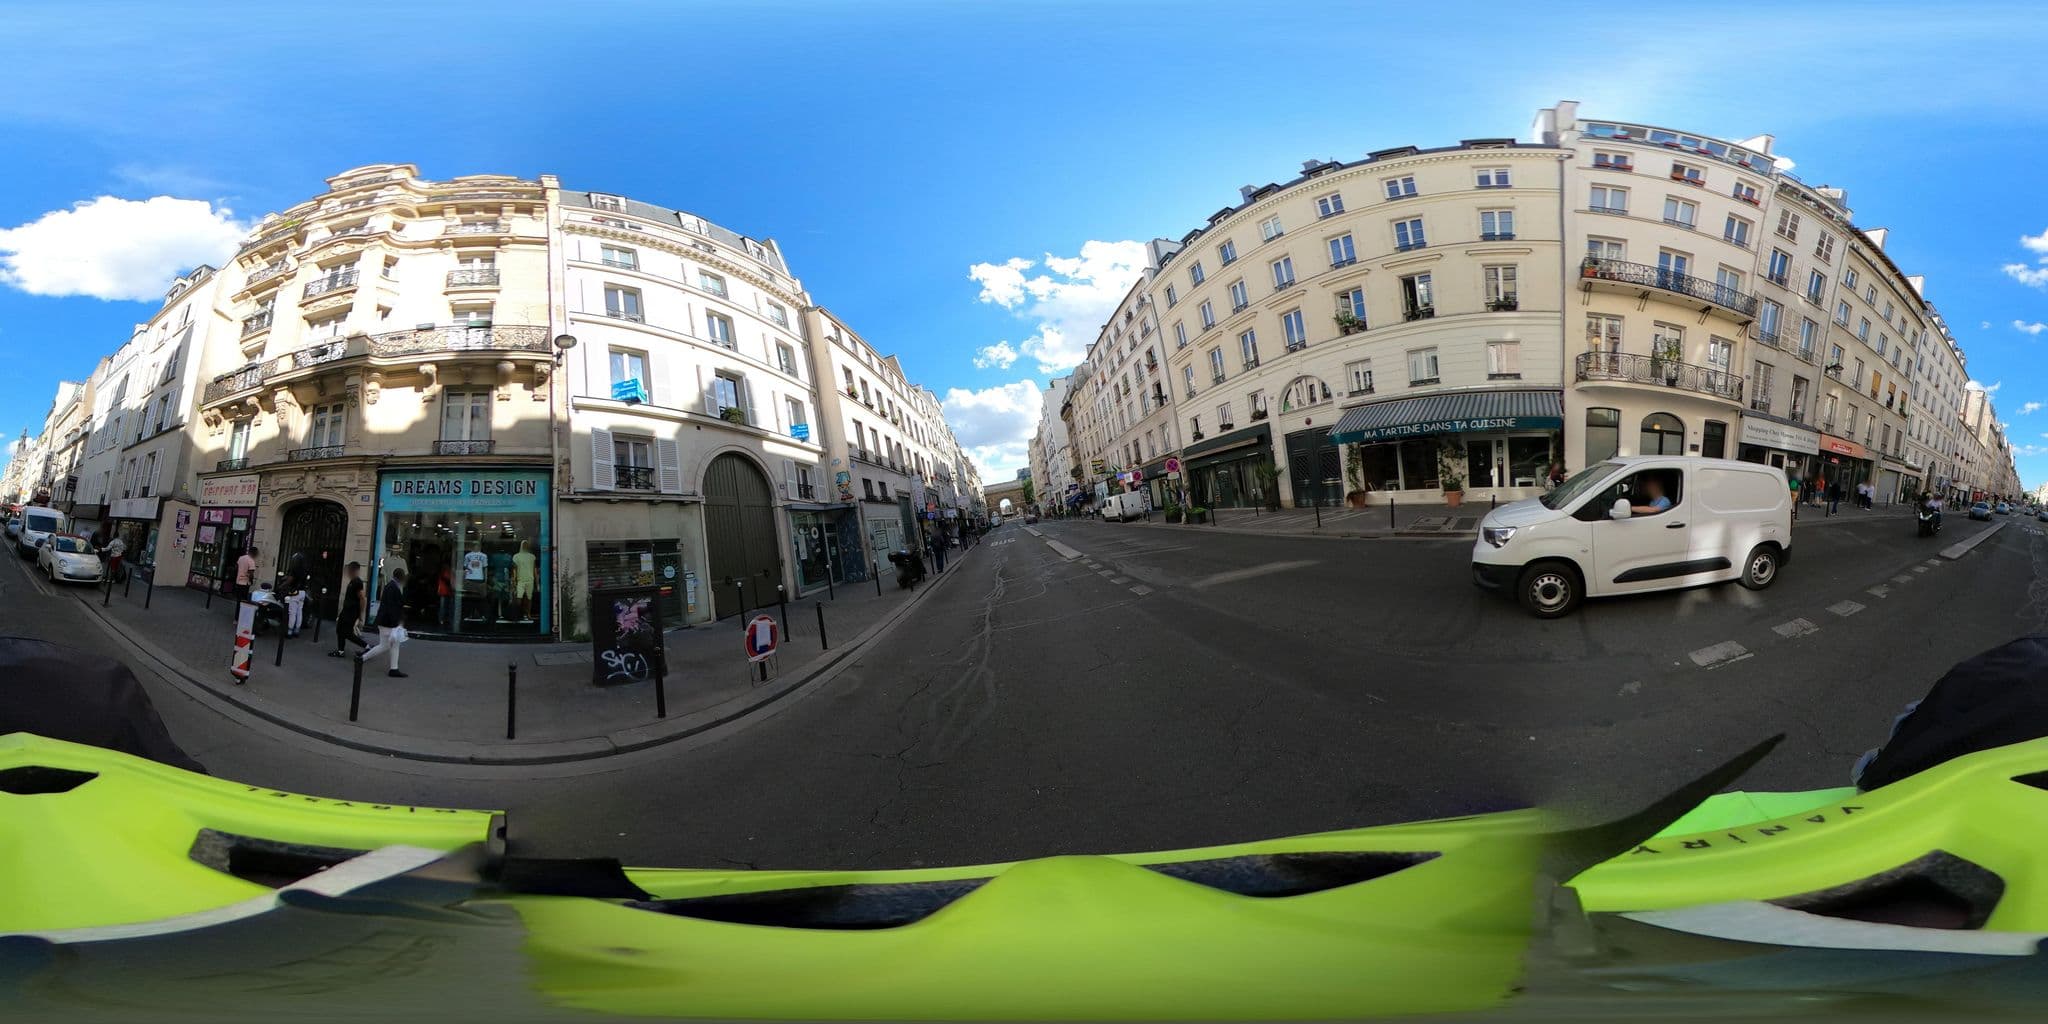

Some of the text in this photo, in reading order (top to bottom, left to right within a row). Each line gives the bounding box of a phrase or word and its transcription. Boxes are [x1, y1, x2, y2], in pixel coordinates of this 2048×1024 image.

[1363, 418, 1516, 439] MA TARTINE DANS TA CUISINE
[392, 479, 537, 497] DREAMS DESIGN
